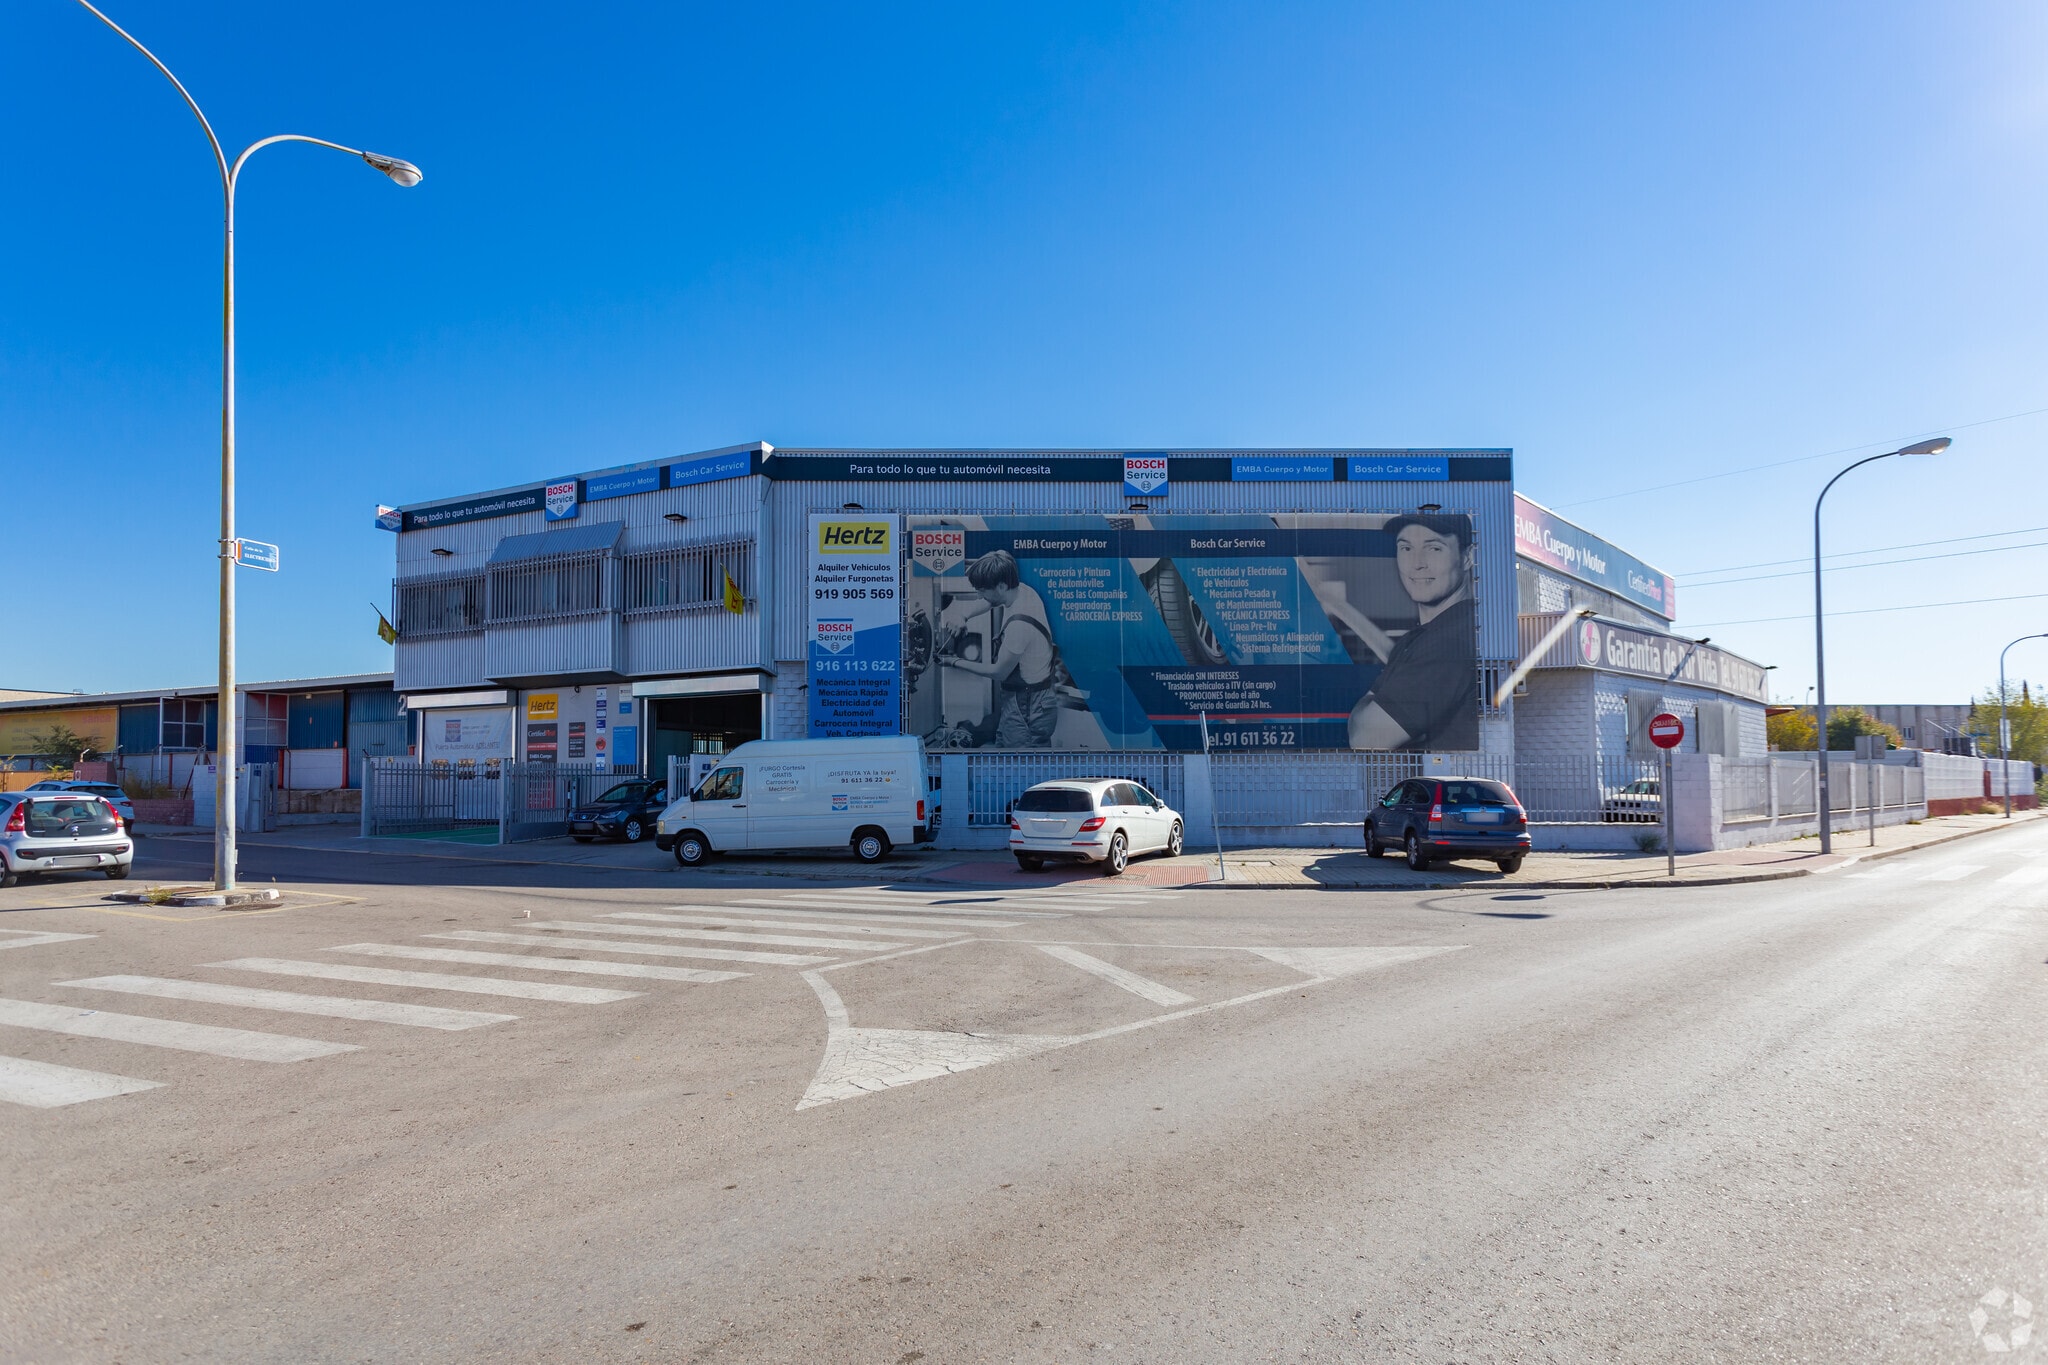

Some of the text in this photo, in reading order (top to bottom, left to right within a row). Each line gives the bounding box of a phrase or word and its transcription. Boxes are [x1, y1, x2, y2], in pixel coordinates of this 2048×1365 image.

[1125, 459, 1166, 469] BOSCH
[1354, 464, 1442, 474] Bosch Car Service
[675, 461, 745, 479] Bosch Car Service
[850, 463, 1051, 477] Para todo lo que tu automóvil necesita
[1125, 470, 1166, 480] Service
[1236, 465, 1328, 476] EMBA Cuerpo y Motor
[547, 484, 574, 496] BOSCH
[589, 484, 607, 493] EMBA
[608, 481, 631, 491] Cuerpo
[637, 477, 656, 485] Motor
[547, 495, 573, 506] Service
[380, 508, 400, 518] BOSCH
[414, 496, 535, 524] Para todo lo que tu automóvil necesita
[824, 527, 886, 544] Hertz
[915, 534, 961, 544] BOSCH
[1014, 539, 1107, 550] EMBA Cuerpo y Motor
[1191, 538, 1265, 549] Bosch Car Service
[1515, 514, 1606, 574] EMBA Cuerpo y Motor
[915, 547, 962, 557] Service
[818, 563, 891, 572] Alquiler Vehículos
[1039, 567, 1110, 578] Carrocería y Pintura
[1197, 567, 1287, 578] Electricidad y Electrónica
[815, 575, 894, 584] Alquiler Furgonetas
[1048, 579, 1104, 588] de Automóviles
[1204, 578, 1249, 587] de Vehículos
[815, 589, 894, 599] 919 905 569
[1053, 590, 1128, 600] Todas las Compañías
[1210, 589, 1277, 599] Mecánica Pesada y
[1062, 601, 1111, 611] Aseguradoras
[1216, 600, 1282, 609] de Mantenimiento
[1065, 610, 1143, 621] CARROCERÍA EXPRESS
[1221, 610, 1290, 620] MECÁNICA EXPRESS
[818, 624, 853, 632] BOSCH
[1230, 622, 1249, 631] Línea
[818, 633, 853, 641] Service
[1236, 632, 1324, 643] Neumáticos y Alineación
[1242, 643, 1320, 654] Sistema Refrigeración
[1607, 630, 1661, 673] Garantía
[1664, 642, 1677, 675] de
[1696, 649, 1718, 684] Vida
[816, 660, 895, 671] 916 113 622
[1156, 672, 1239, 681] Financiación SIN INTERESES
[858, 679, 890, 687] Integral
[1168, 682, 1193, 690] Traslado
[1195, 681, 1224, 690] vehículos
[1231, 681, 1241, 689] ITV
[1242, 681, 1254, 690] (sin
[1256, 681, 1276, 690] cargo)
[1179, 691, 1260, 700] PROMOCIONES todo el año
[397, 695, 407, 716] 2
[530, 700, 555, 711] Hertz
[1190, 700, 1271, 710] Servicio de Guardia 24 hrs.
[860, 720, 892, 728] Integral
[1241, 732, 1259, 745] 611
[1263, 732, 1277, 745] 36
[1281, 732, 1295, 745] 22
